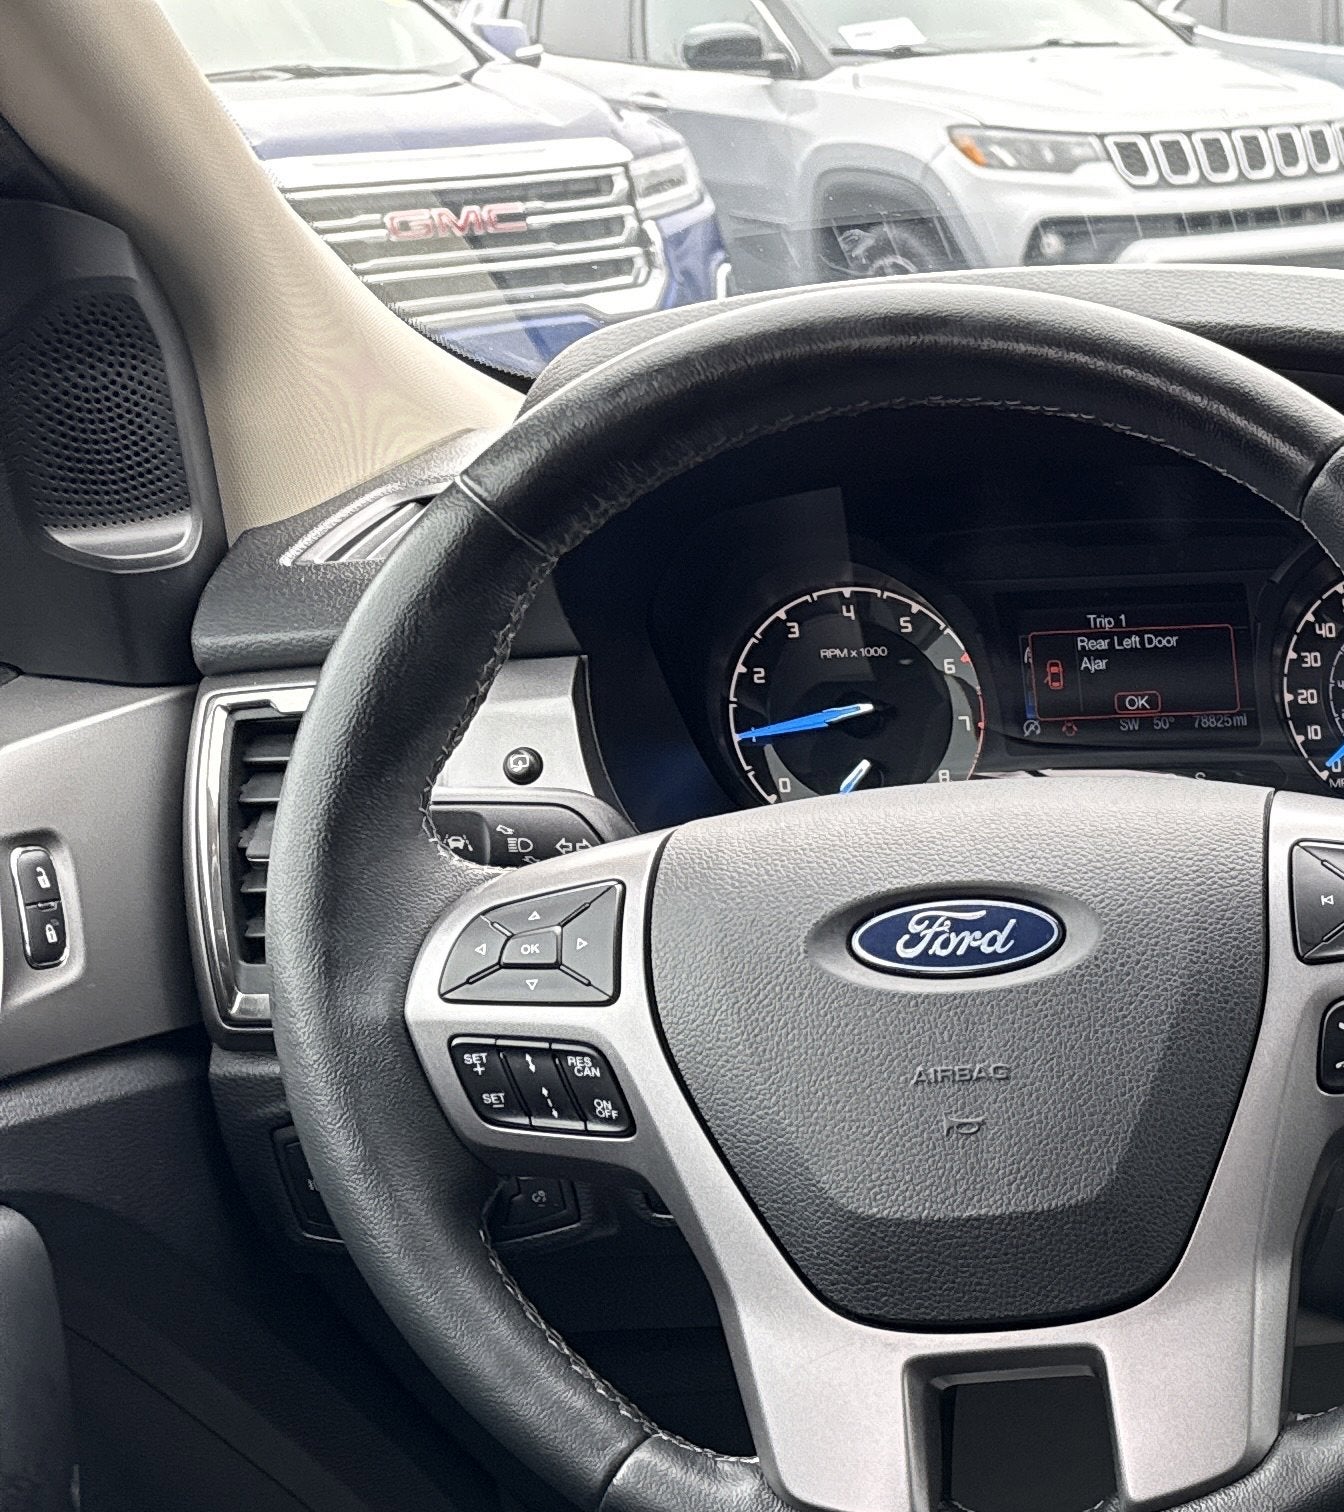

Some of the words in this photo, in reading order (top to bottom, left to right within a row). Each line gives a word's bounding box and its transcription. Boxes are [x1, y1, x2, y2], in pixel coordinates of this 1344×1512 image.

[384, 202, 528, 241] GMC
[842, 605, 855, 620] 4
[900, 617, 913, 632] 5
[1086, 614, 1114, 630] Trip
[1119, 614, 1126, 627] 1
[787, 622, 799, 638] 3
[1315, 623, 1336, 638] 40
[1077, 637, 1110, 650] Rear
[1114, 635, 1141, 650] Left
[1144, 634, 1178, 648] Door
[820, 648, 848, 659] RPM
[860, 646, 887, 657] 1000
[1301, 653, 1321, 667] 30
[943, 659, 955, 674] 6
[1080, 657, 1108, 673] Ajar
[753, 668, 765, 683] 2
[1125, 696, 1150, 710] OK
[1297, 690, 1317, 704] 20
[958, 716, 970, 731] 7
[1119, 718, 1139, 731] SW
[1307, 725, 1322, 740] 10
[1331, 759, 1342, 772] 0
[778, 778, 790, 793] 0
[896, 909, 1018, 958] Ford
[520, 942, 540, 956] OK
[463, 1053, 488, 1065] SET
[567, 1056, 592, 1067] RES
[574, 1066, 600, 1078] CAN
[913, 1064, 1011, 1085] AIRBAG
[482, 1092, 505, 1105] SET
[593, 1099, 612, 1111] ON
[595, 1108, 619, 1120] OFF
